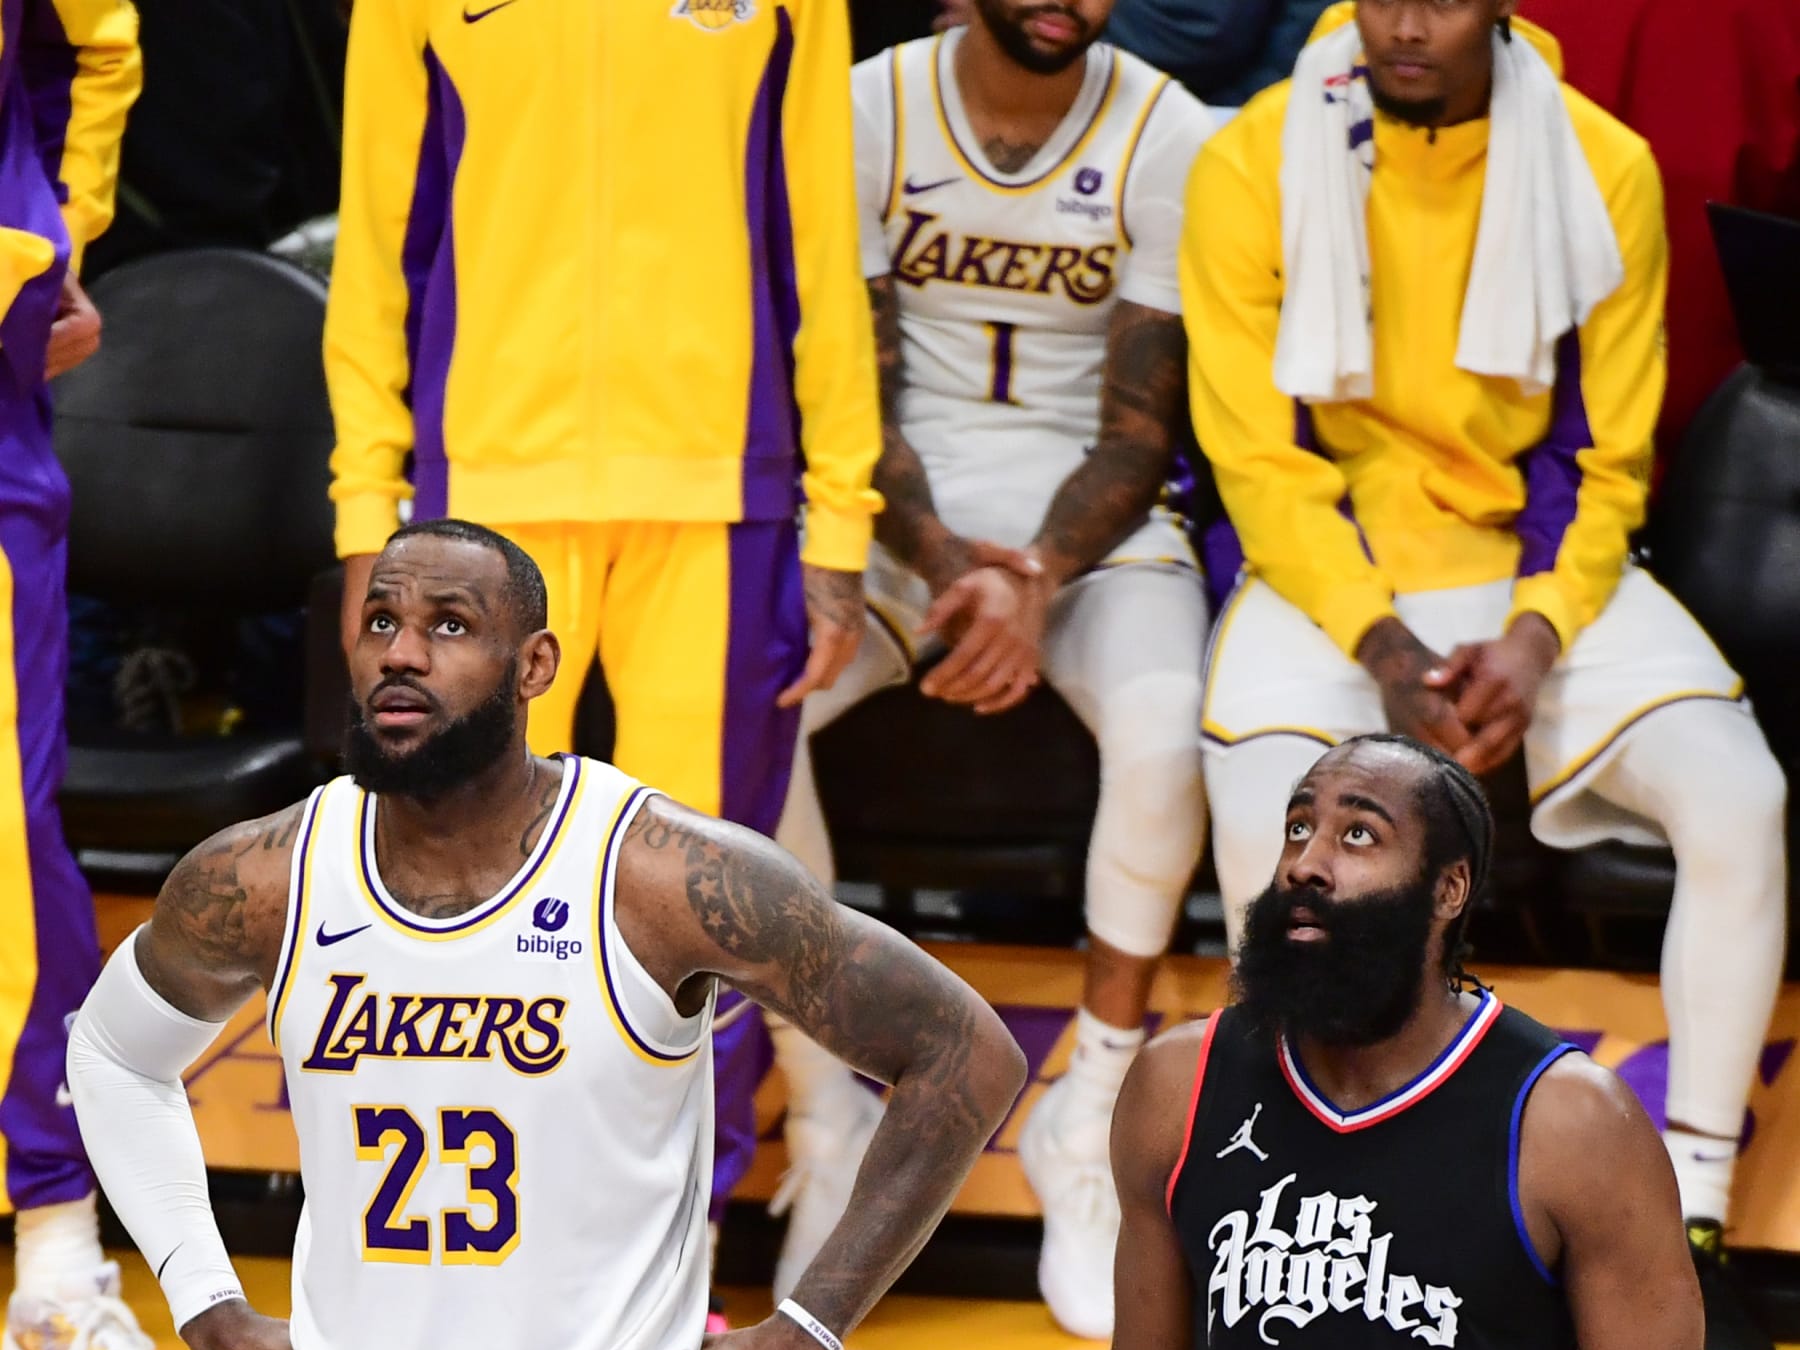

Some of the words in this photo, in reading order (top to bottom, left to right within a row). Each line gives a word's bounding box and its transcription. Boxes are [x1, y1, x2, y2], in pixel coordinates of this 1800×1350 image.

[889, 208, 1119, 305] LAKERS
[983, 318, 1023, 406] 1
[516, 934, 583, 960] bibigo
[300, 971, 570, 1078] LAKERS
[351, 1104, 521, 1266] 23
[1245, 1172, 1378, 1257] Los
[1207, 1209, 1463, 1349] Angeles
